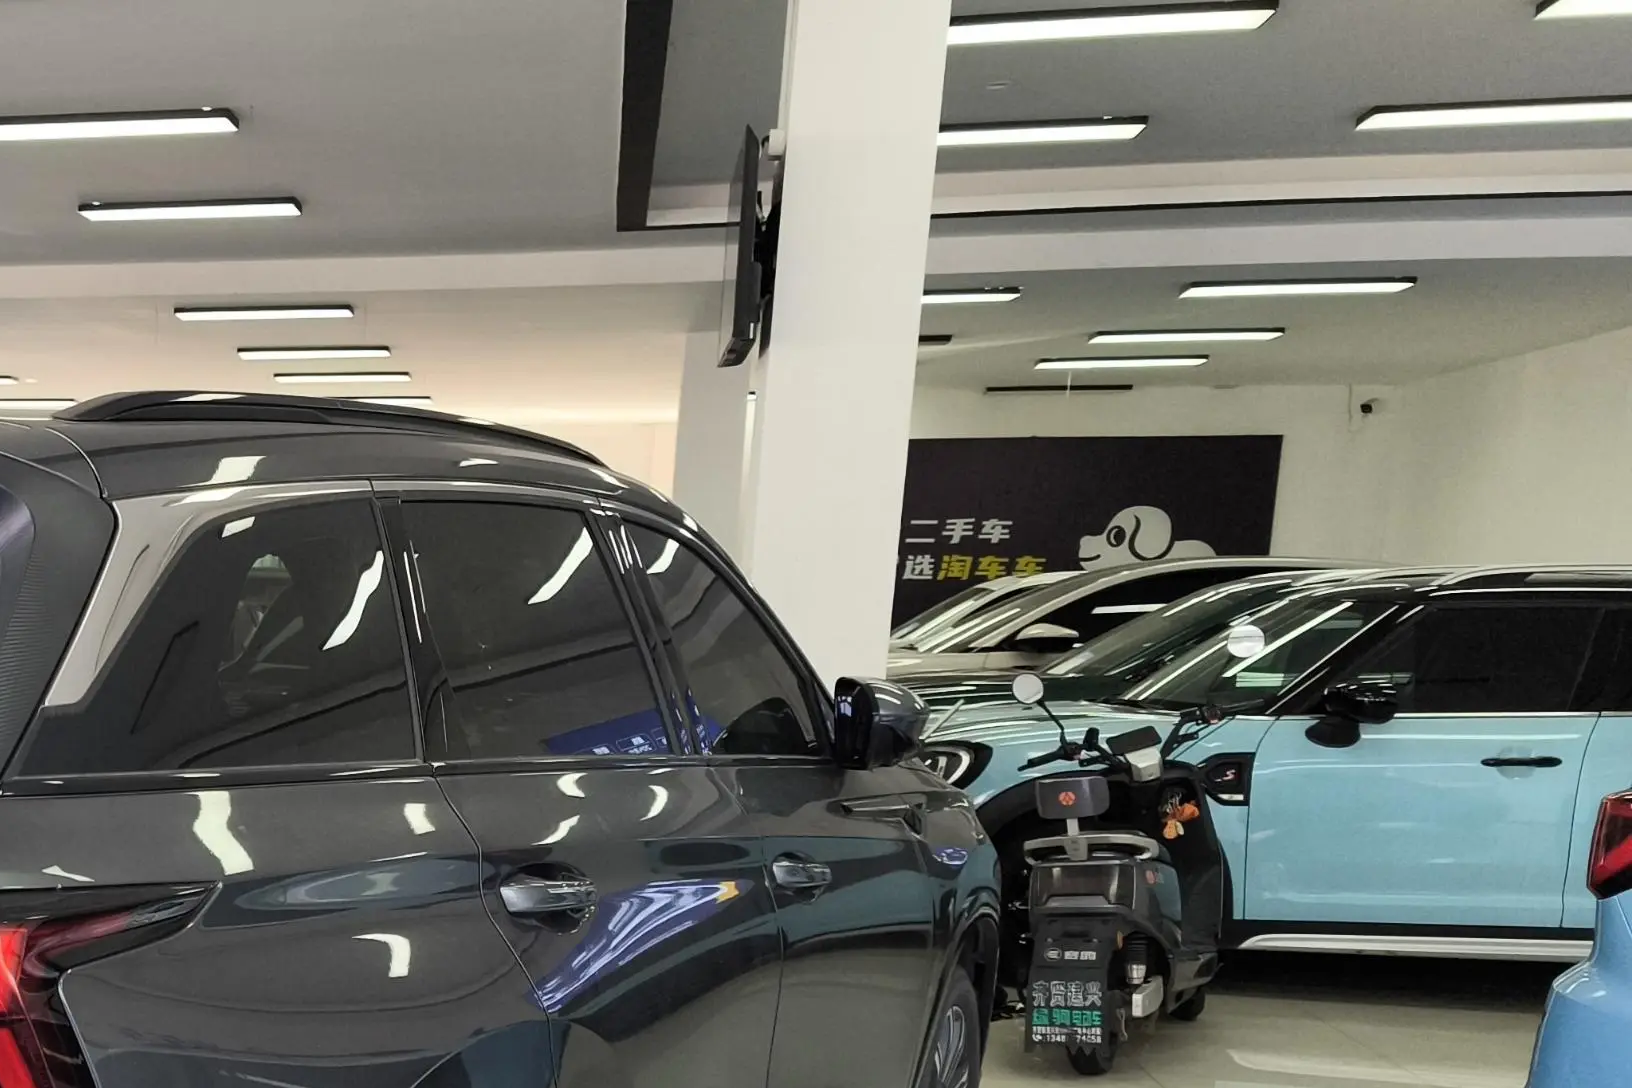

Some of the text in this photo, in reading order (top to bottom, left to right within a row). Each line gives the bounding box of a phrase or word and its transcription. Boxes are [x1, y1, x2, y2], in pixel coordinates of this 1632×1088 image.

[905, 517, 1013, 545] 二手车
[902, 554, 1047, 581] 选淘车车
